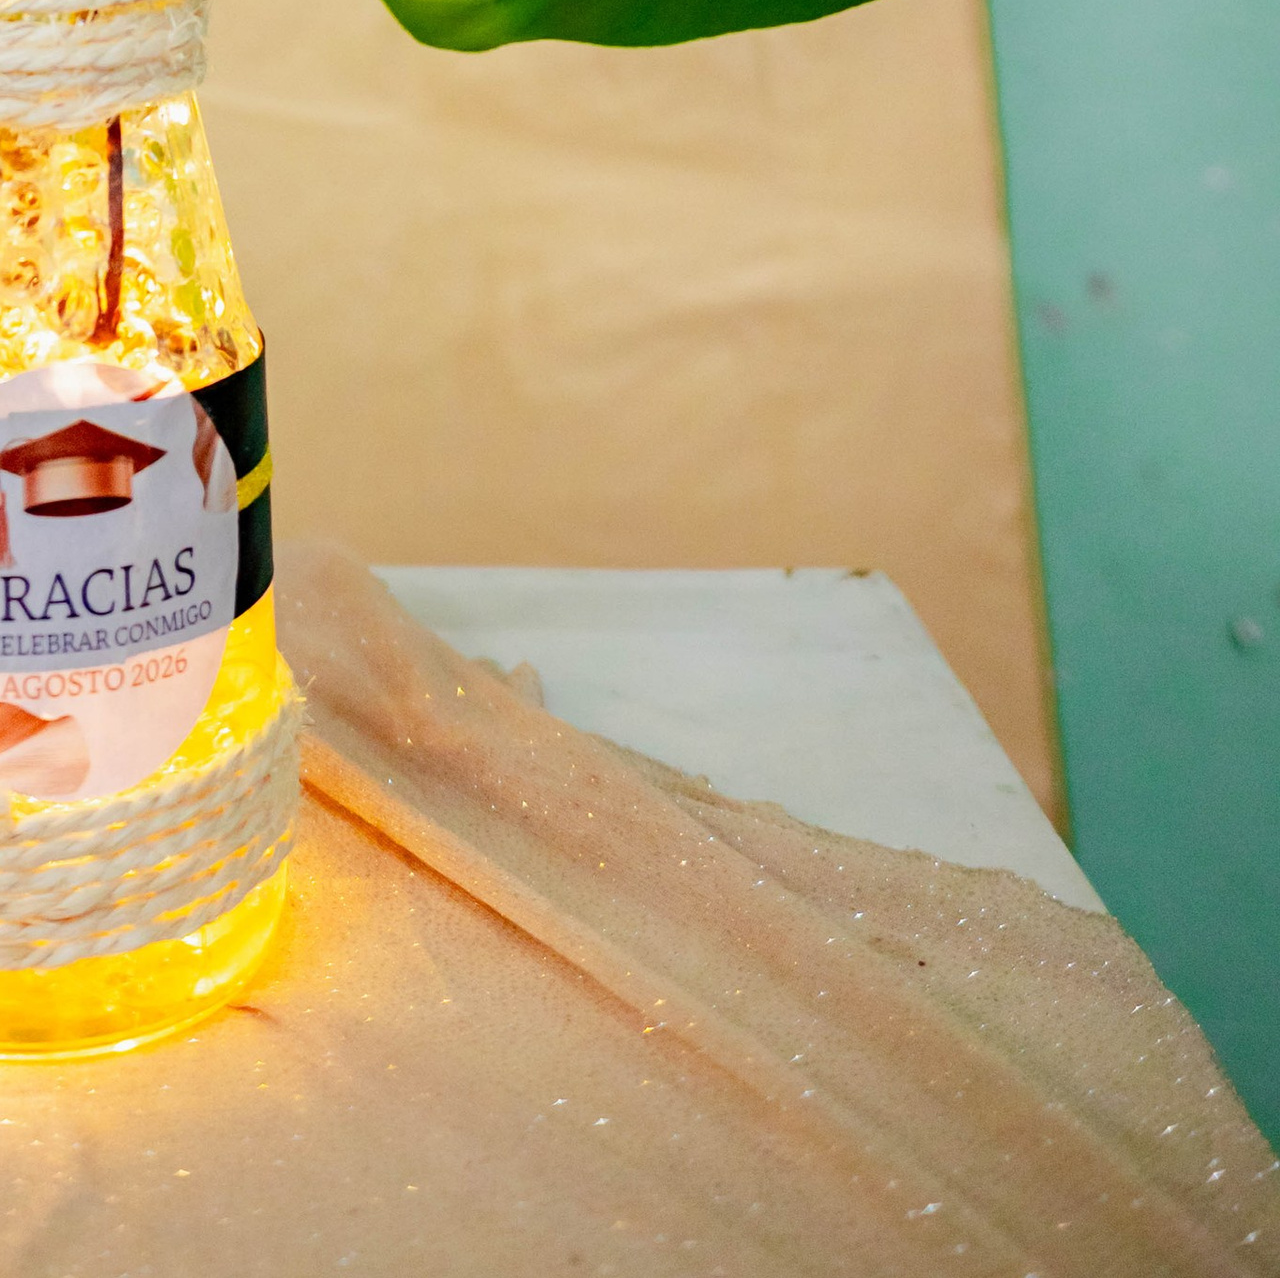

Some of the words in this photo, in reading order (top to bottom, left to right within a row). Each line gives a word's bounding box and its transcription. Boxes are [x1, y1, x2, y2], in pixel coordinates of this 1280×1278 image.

[114, 599, 213, 647] CONMIGO
[0, 666, 126, 700] AGOSTO
[130, 648, 189, 688] 2026
